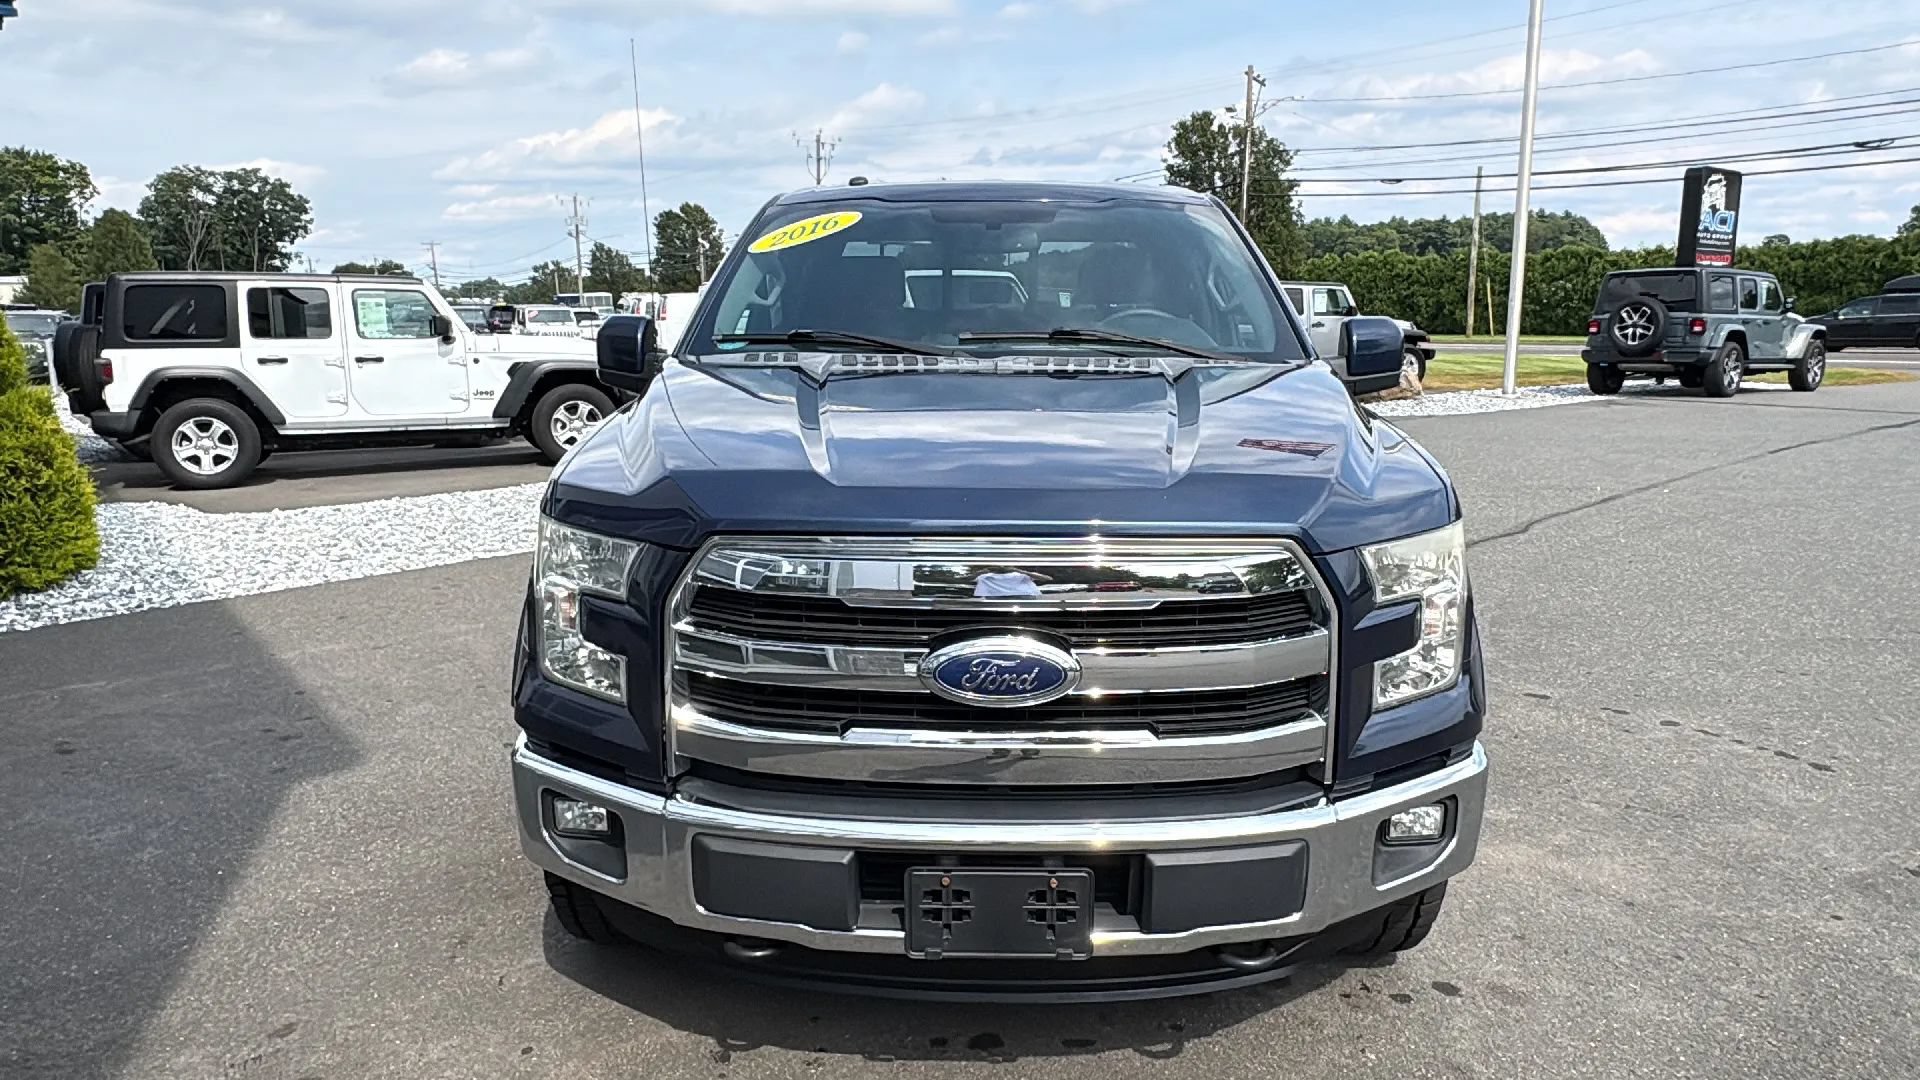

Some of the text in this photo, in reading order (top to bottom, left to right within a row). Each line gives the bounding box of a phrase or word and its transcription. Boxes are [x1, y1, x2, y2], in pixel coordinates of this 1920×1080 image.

[769, 215, 840, 248] 2016
[1698, 208, 1736, 233] ACI
[472, 388, 495, 397] Jeep
[961, 657, 1041, 691] Ford
